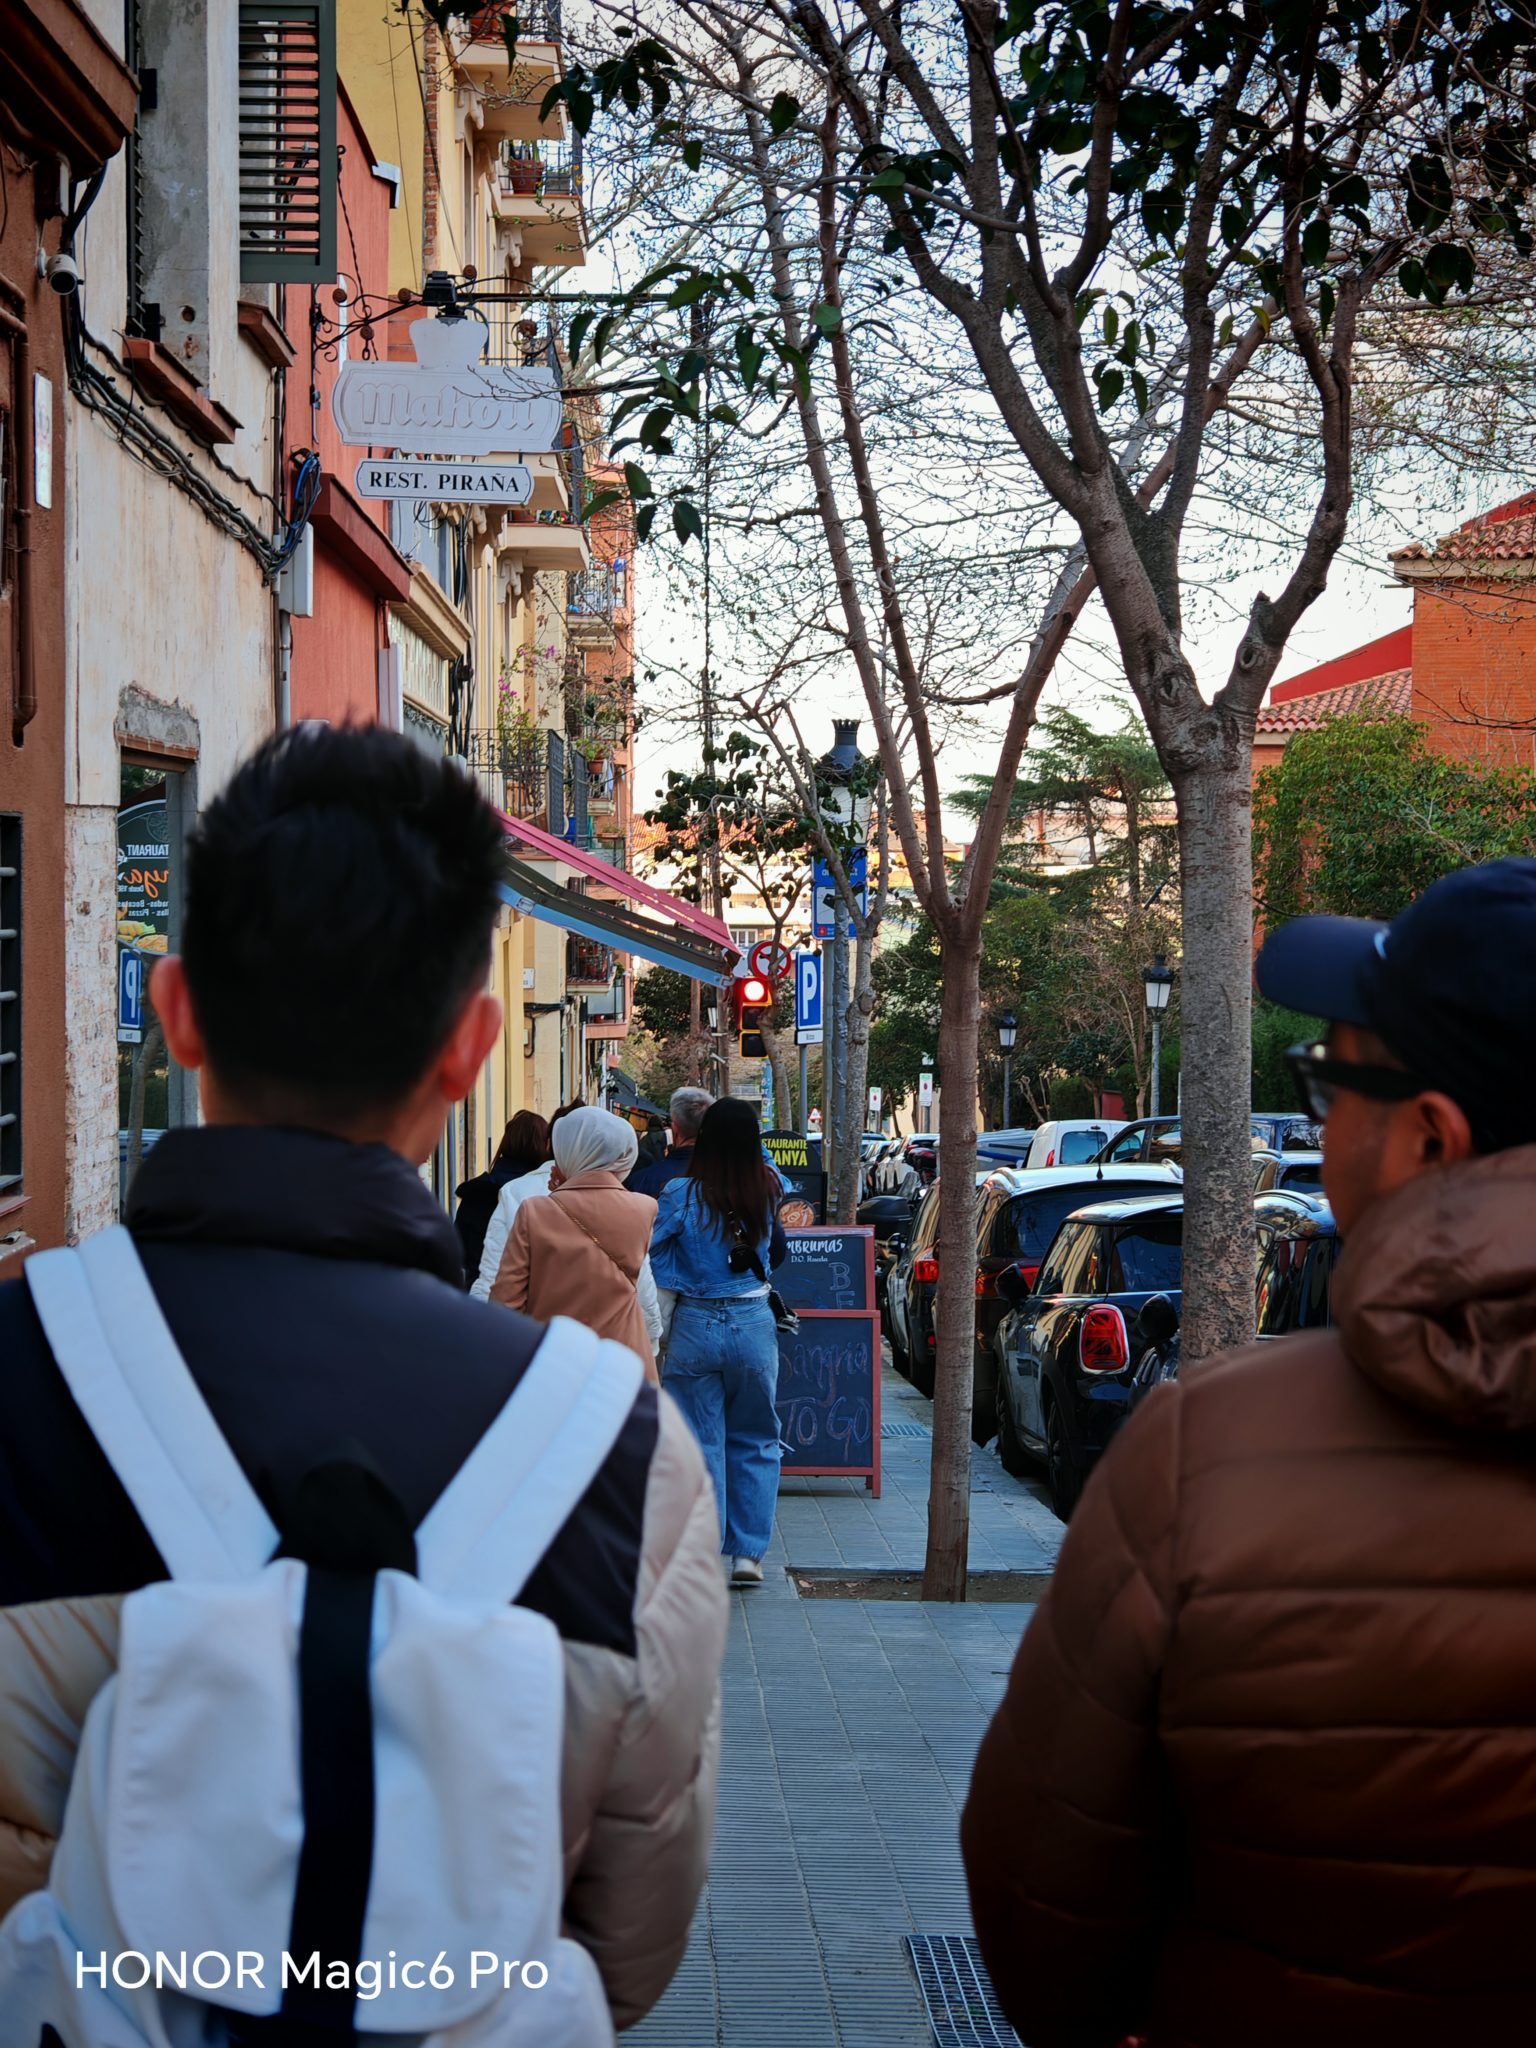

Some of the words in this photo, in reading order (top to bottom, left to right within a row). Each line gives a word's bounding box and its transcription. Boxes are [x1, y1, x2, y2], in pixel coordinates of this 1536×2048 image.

[358, 383, 535, 430] Mahou
[369, 471, 428, 489] REST.
[438, 473, 520, 492] PIRAÑA
[803, 961, 817, 1019] P
